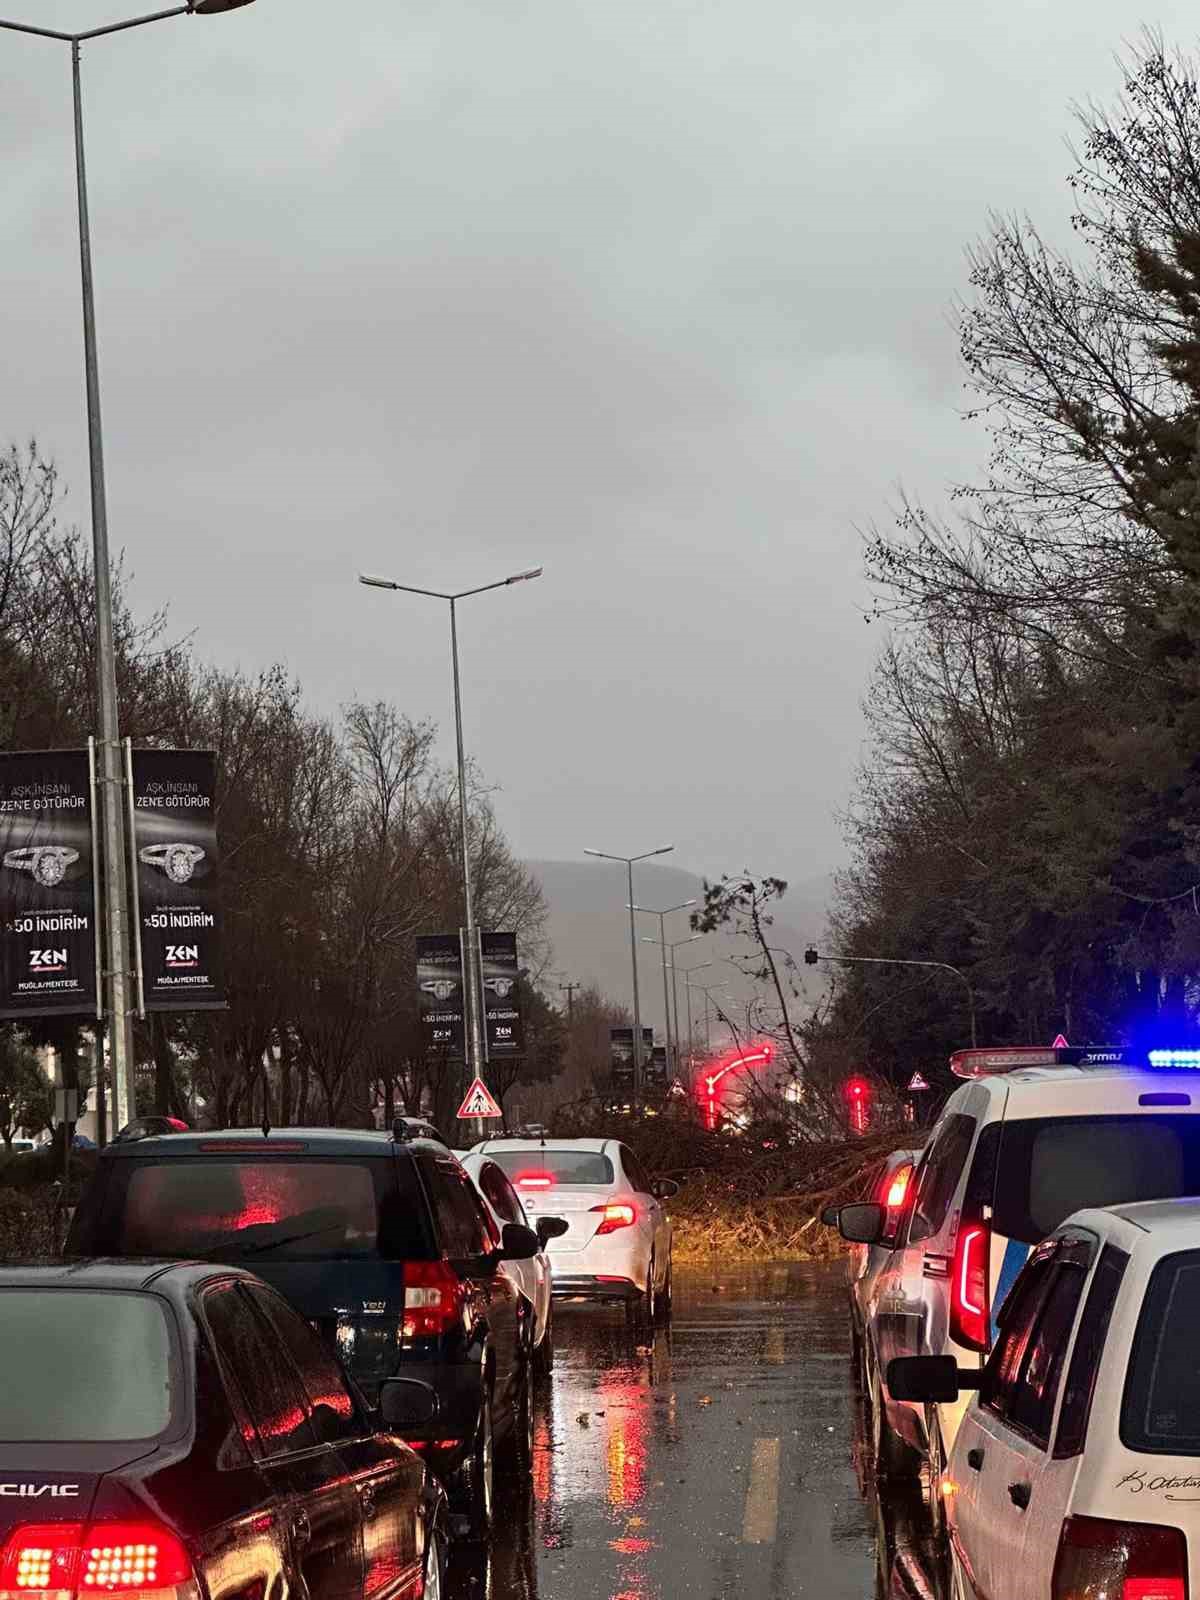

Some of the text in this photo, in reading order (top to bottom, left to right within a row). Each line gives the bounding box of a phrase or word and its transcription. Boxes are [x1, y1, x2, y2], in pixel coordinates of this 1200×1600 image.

[33, 795, 86, 810] GÖTÜRÜR
[165, 794, 211, 808] GÖTÜRÜR
[36, 914, 88, 932] İNDİRİM
[144, 912, 214, 928] %50 İNDİRİM
[29, 948, 67, 966] ZEN
[165, 945, 198, 961] ZEN
